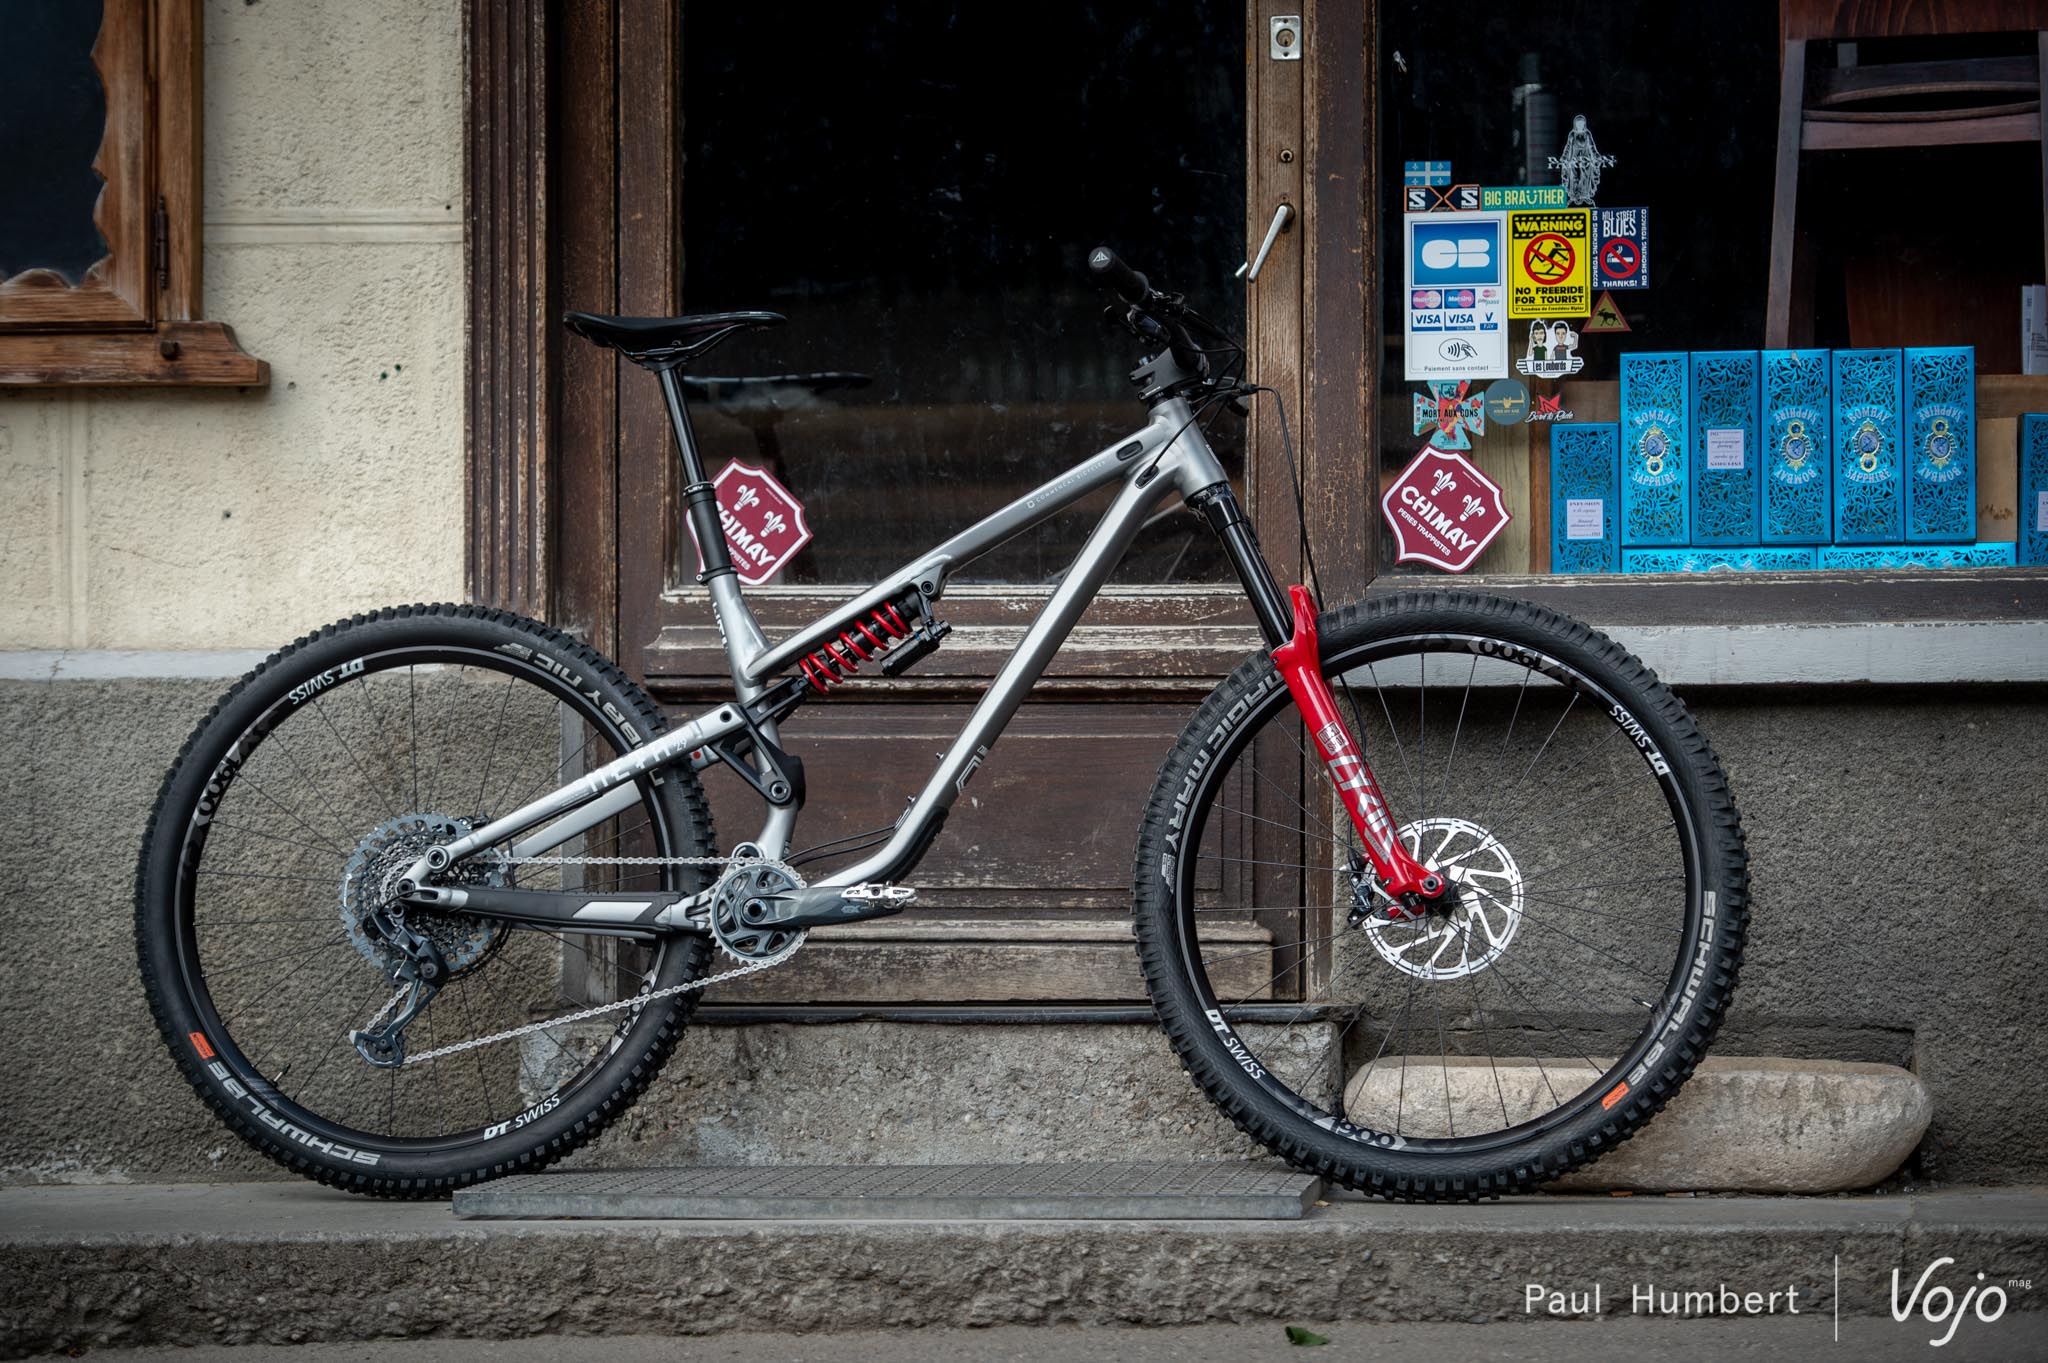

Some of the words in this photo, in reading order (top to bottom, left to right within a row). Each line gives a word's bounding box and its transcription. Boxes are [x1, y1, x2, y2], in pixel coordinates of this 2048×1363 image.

[1484, 191, 1502, 206] BIG
[1592, 210, 1598, 221] NO
[1602, 211, 1615, 220] HILL
[1616, 210, 1637, 220] STREET
[1514, 219, 1584, 232] WARNING
[1603, 218, 1637, 238] BLUES
[1641, 275, 1647, 286] NO
[1515, 287, 1532, 295] NO
[1535, 286, 1584, 295] FREERIDE
[1515, 296, 1536, 304] FOR
[1540, 295, 1584, 304] TOURIST
[1415, 314, 1441, 324] VISA
[1448, 313, 1474, 323] VISA
[1533, 360, 1542, 372] Les
[1422, 408, 1441, 418] MORT
[1444, 408, 1457, 418] AUX
[1460, 407, 1478, 418] CONS
[1553, 410, 1574, 421] Ride
[1635, 410, 1677, 429] BOMBAY
[1774, 407, 1819, 425] SAPPHIRE
[1848, 406, 1890, 425] BOMBAY
[1917, 405, 1962, 423] SAPPHIRE
[1632, 469, 1678, 487] SAPPHIRE
[1775, 466, 1818, 485] BOMBAY
[1845, 466, 1892, 484] SAPPHIRE
[1918, 464, 1962, 483] BOMBAY
[1400, 486, 1477, 552] CHIMAY
[1416, 523, 1451, 557] TRAPPISTES
[338, 657, 366, 680] DT
[533, 652, 583, 687] NIC
[287, 670, 335, 705] SWISS
[1608, 703, 1653, 749] SWISS
[673, 738, 688, 752] 29
[1645, 750, 1672, 777] DT
[1165, 748, 1211, 852] MARY
[1626, 890, 1717, 1086] SCHWALBE
[1205, 1008, 1231, 1035] DT
[1223, 1036, 1267, 1080] SWISS
[208, 1060, 382, 1167] SCHWALBE
[483, 1120, 511, 1141] DT
[515, 1093, 560, 1128] SWISS
